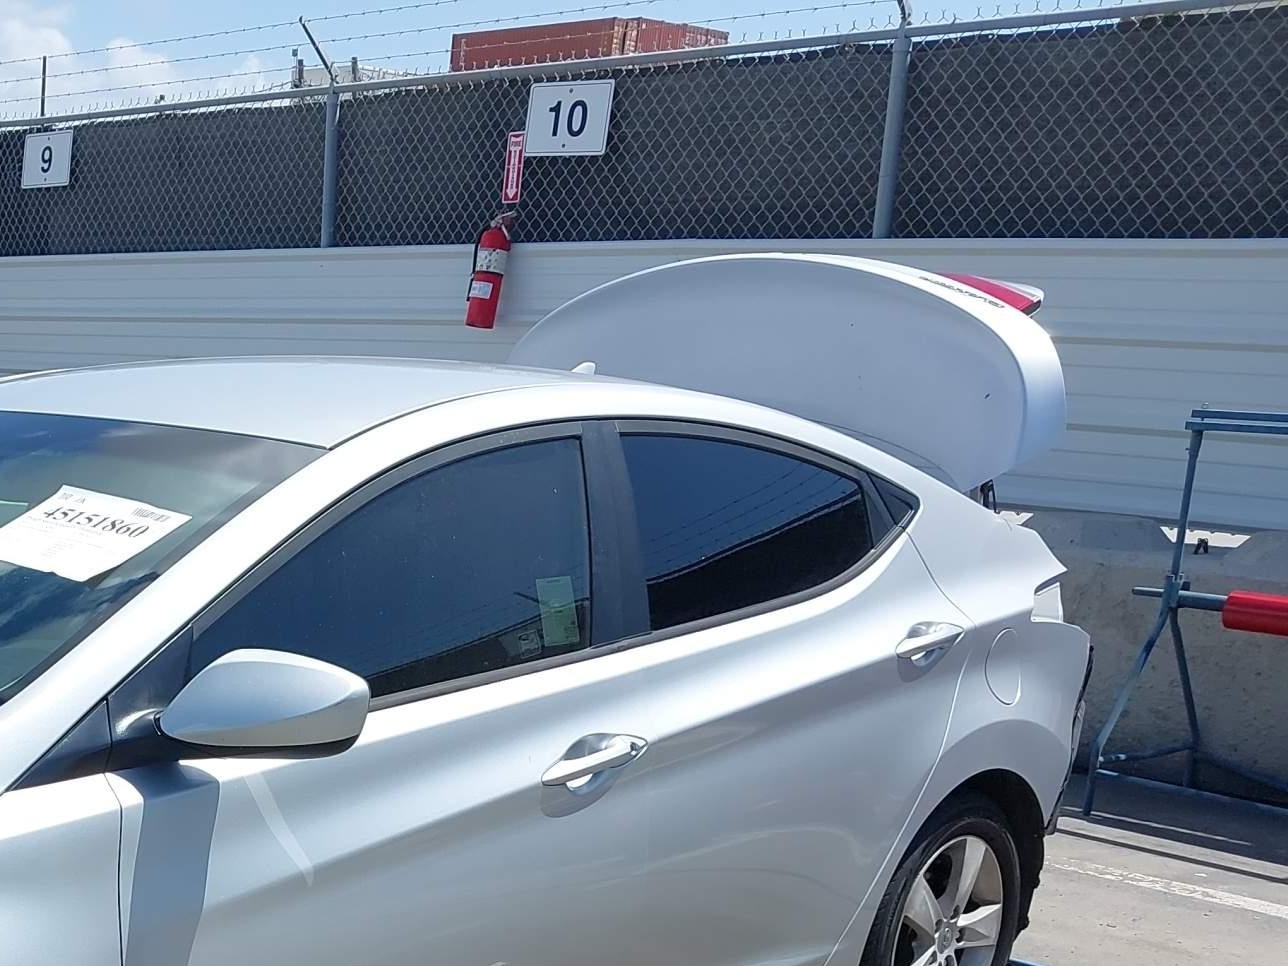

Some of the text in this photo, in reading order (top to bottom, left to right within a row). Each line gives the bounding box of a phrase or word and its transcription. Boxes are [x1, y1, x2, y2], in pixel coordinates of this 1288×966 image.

[548, 99, 588, 137] 10
[40, 145, 53, 174] 9
[43, 505, 150, 538] 45151860
